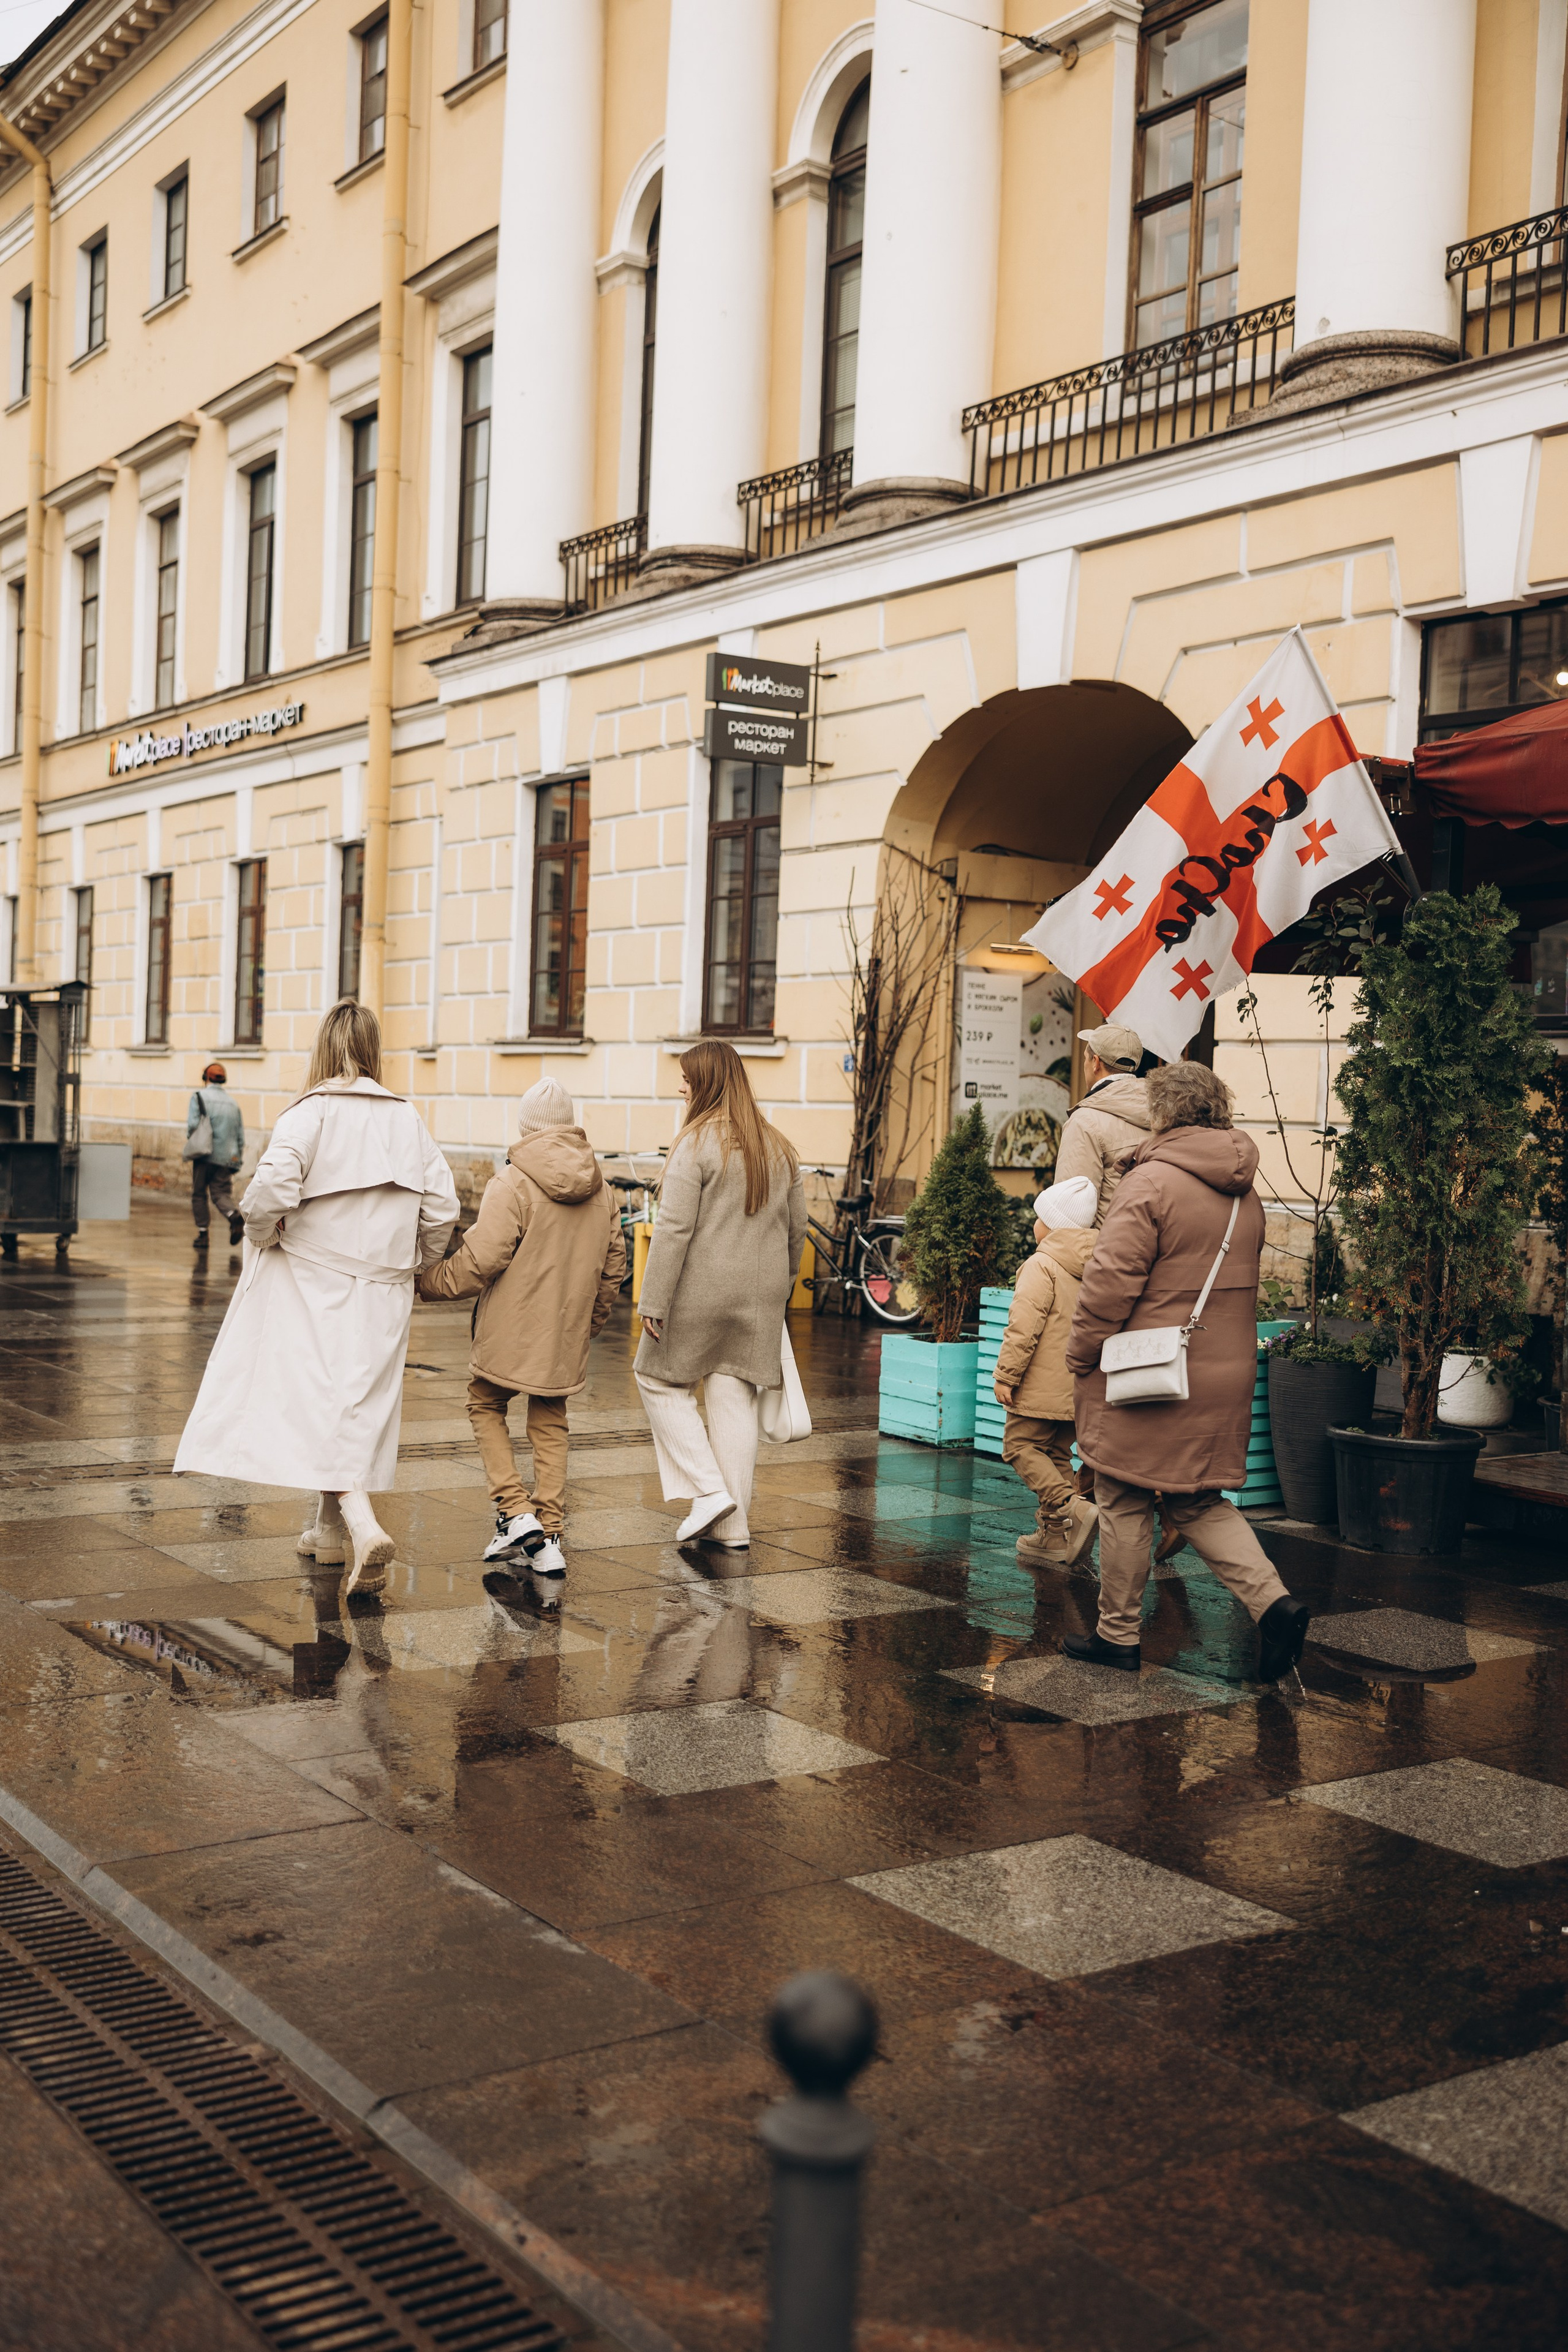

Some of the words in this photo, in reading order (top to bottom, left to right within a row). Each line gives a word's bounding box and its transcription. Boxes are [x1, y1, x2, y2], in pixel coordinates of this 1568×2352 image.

[729, 673, 804, 698] Marketplace
[185, 701, 304, 756] ресторан-маркет
[728, 720, 794, 740] ресторан
[734, 737, 787, 755] маркет
[966, 1030, 983, 1041] 239
